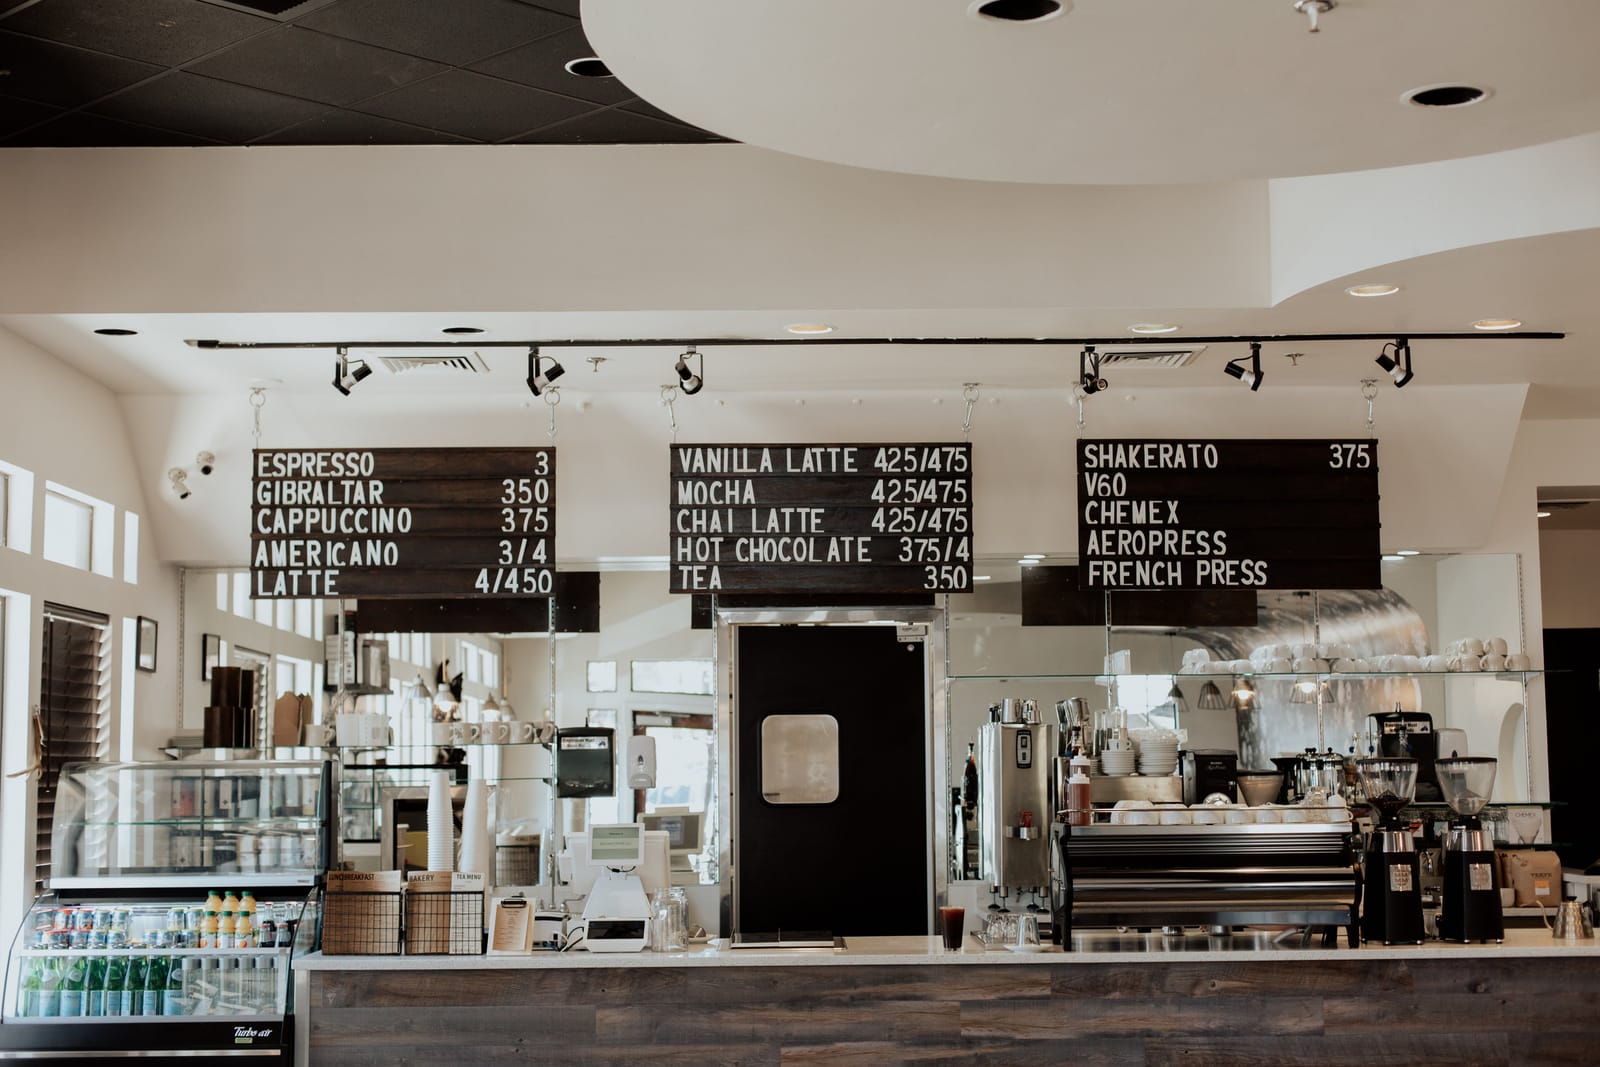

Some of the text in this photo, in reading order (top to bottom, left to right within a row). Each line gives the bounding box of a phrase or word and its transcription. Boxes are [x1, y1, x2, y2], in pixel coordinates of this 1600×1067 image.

[257, 451, 549, 478] ESPRESSO 3
[678, 447, 968, 473] VANILLA LATTE 425/475
[1084, 444, 1370, 468] SHAKERATO 375
[256, 478, 549, 505] GIBRALTAR 350
[678, 478, 967, 505] MOCHA 425/475
[1084, 471, 1127, 497] V60
[257, 507, 548, 535] CAPPUCCINO 375
[676, 507, 968, 533] CHAI LATTE 425/475
[1085, 500, 1179, 524] CHEMEX
[254, 538, 547, 568] AMERICANO 3/4
[677, 536, 970, 562] HOT CHOCOLATE 375/4
[1087, 529, 1227, 555] AEROPRESS
[257, 567, 553, 596] LATTE 4/450
[678, 565, 967, 590] TEA 350
[1088, 559, 1268, 586] FRENCH PRESS
[409, 874, 434, 882] BAKERY
[234, 1026, 273, 1037] Turbo air
